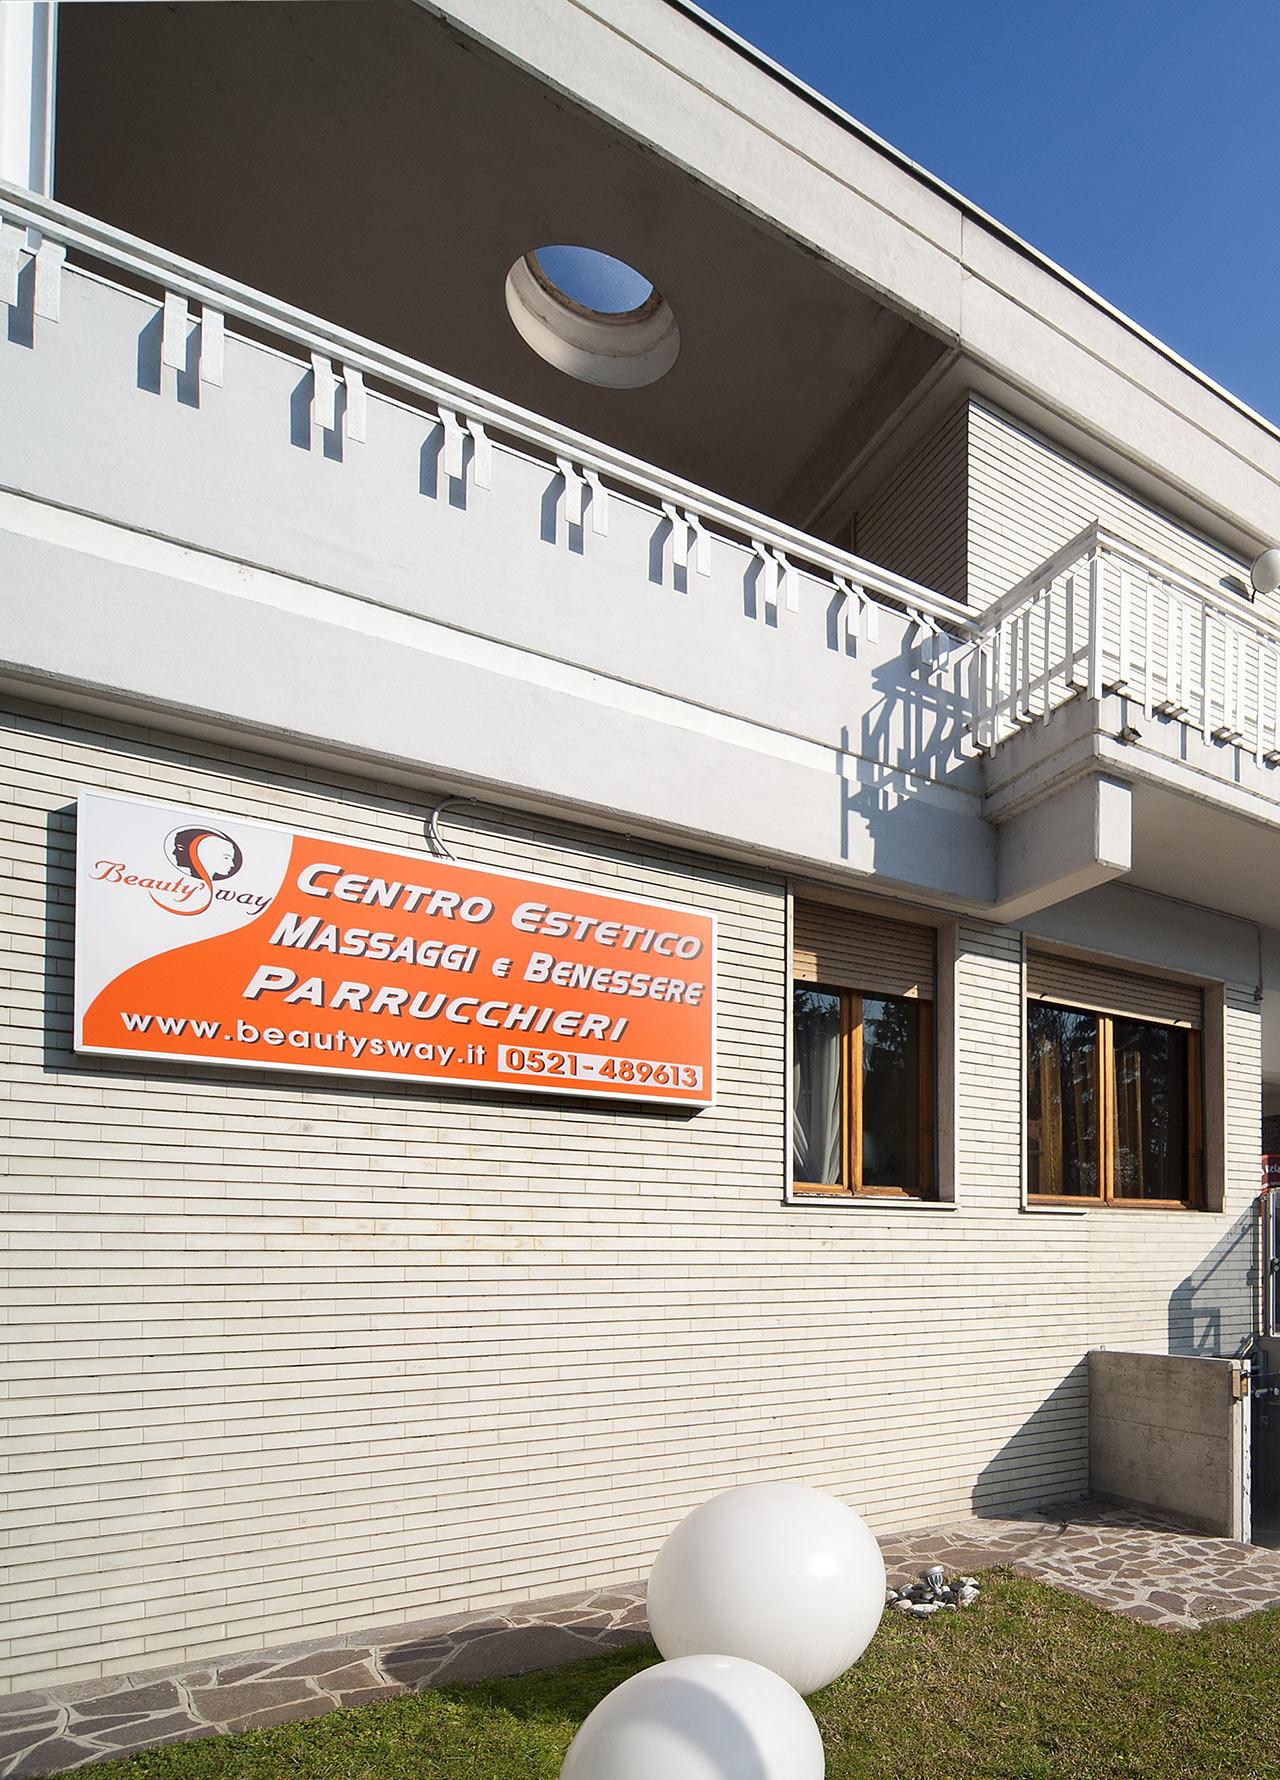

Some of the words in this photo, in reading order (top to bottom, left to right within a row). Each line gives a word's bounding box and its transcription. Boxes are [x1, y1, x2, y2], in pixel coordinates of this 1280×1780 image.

[268, 912, 480, 974] MASSAGGI
[523, 951, 706, 1007] BENESSERE
[242, 964, 630, 1043] PARRUCCHIERI
[120, 1012, 487, 1067] www.beautysway.it
[505, 1047, 699, 1089] 0521-489613
